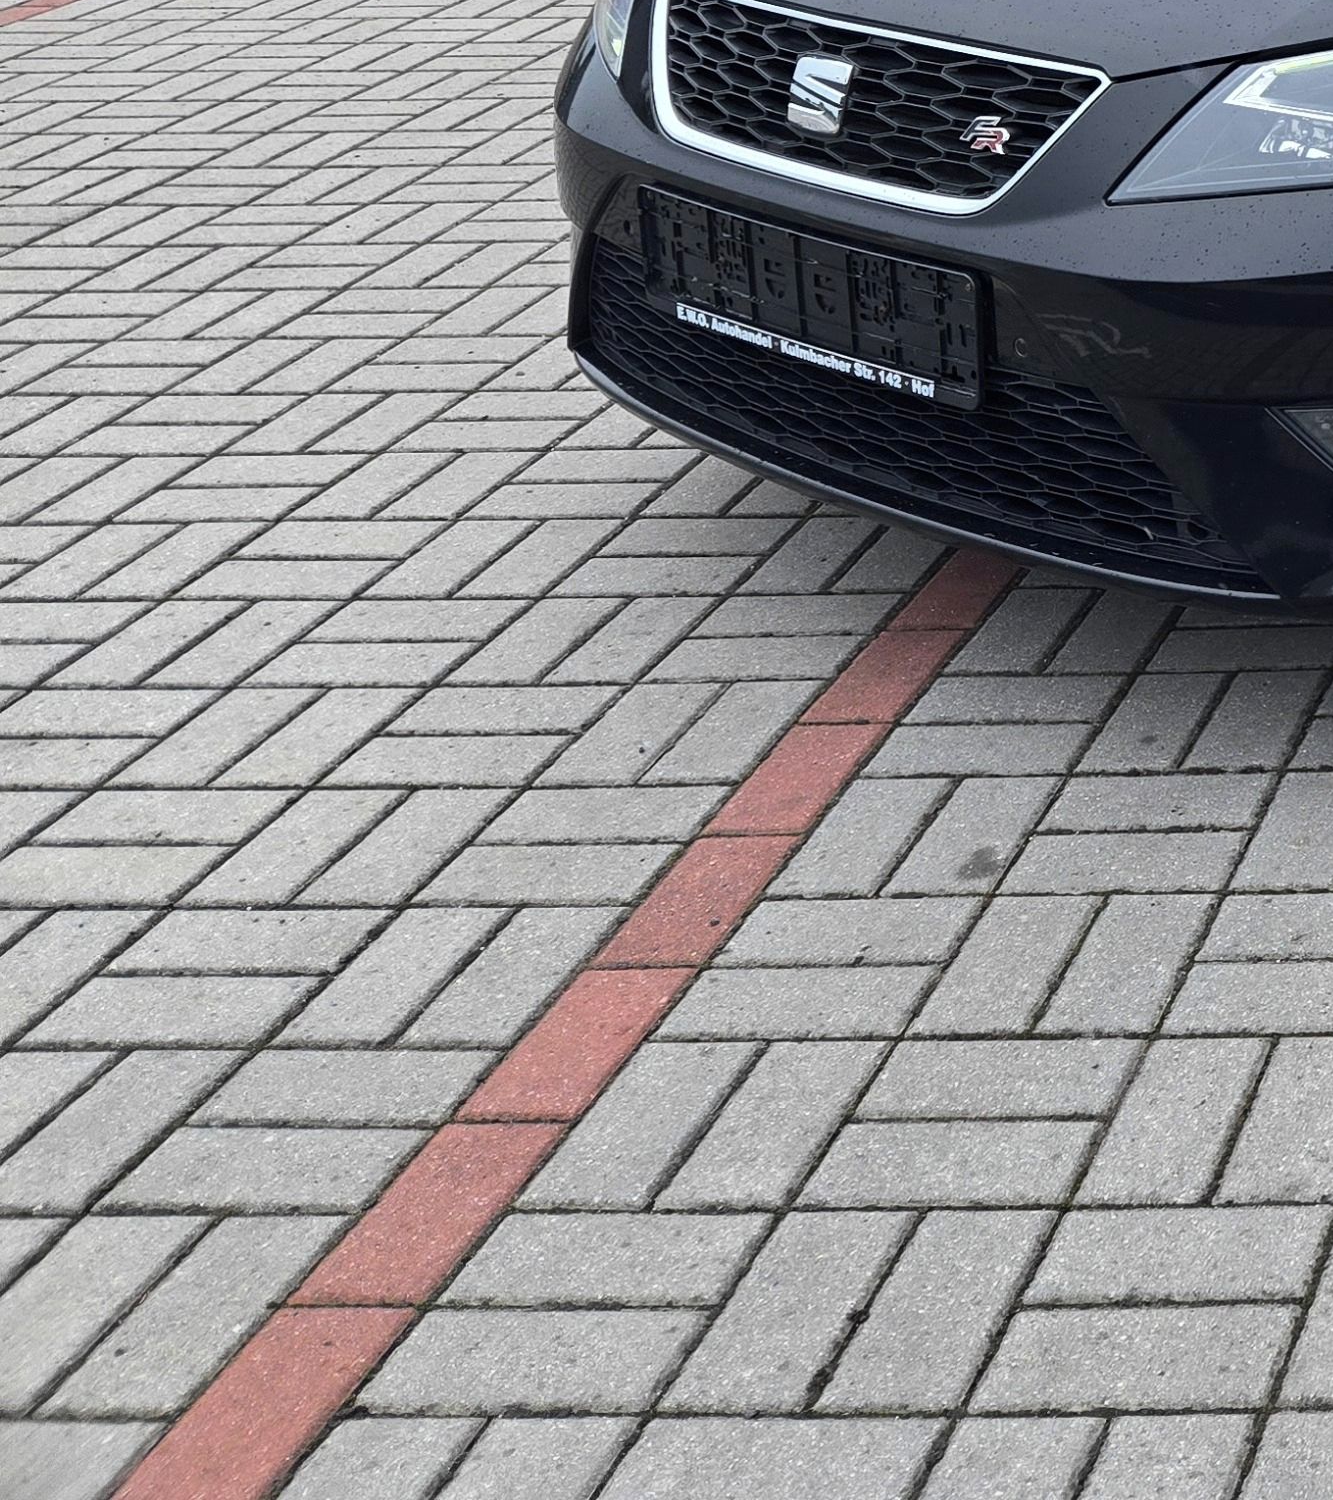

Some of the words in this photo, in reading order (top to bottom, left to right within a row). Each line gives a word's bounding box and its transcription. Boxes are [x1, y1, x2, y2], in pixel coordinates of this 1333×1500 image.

[676, 305, 709, 329] E.W.O.
[711, 317, 773, 349] Autohandel
[780, 339, 851, 374] Kulmbacher
[853, 362, 876, 382] Str.
[878, 370, 902, 389] 142
[911, 378, 935, 398] Hof
